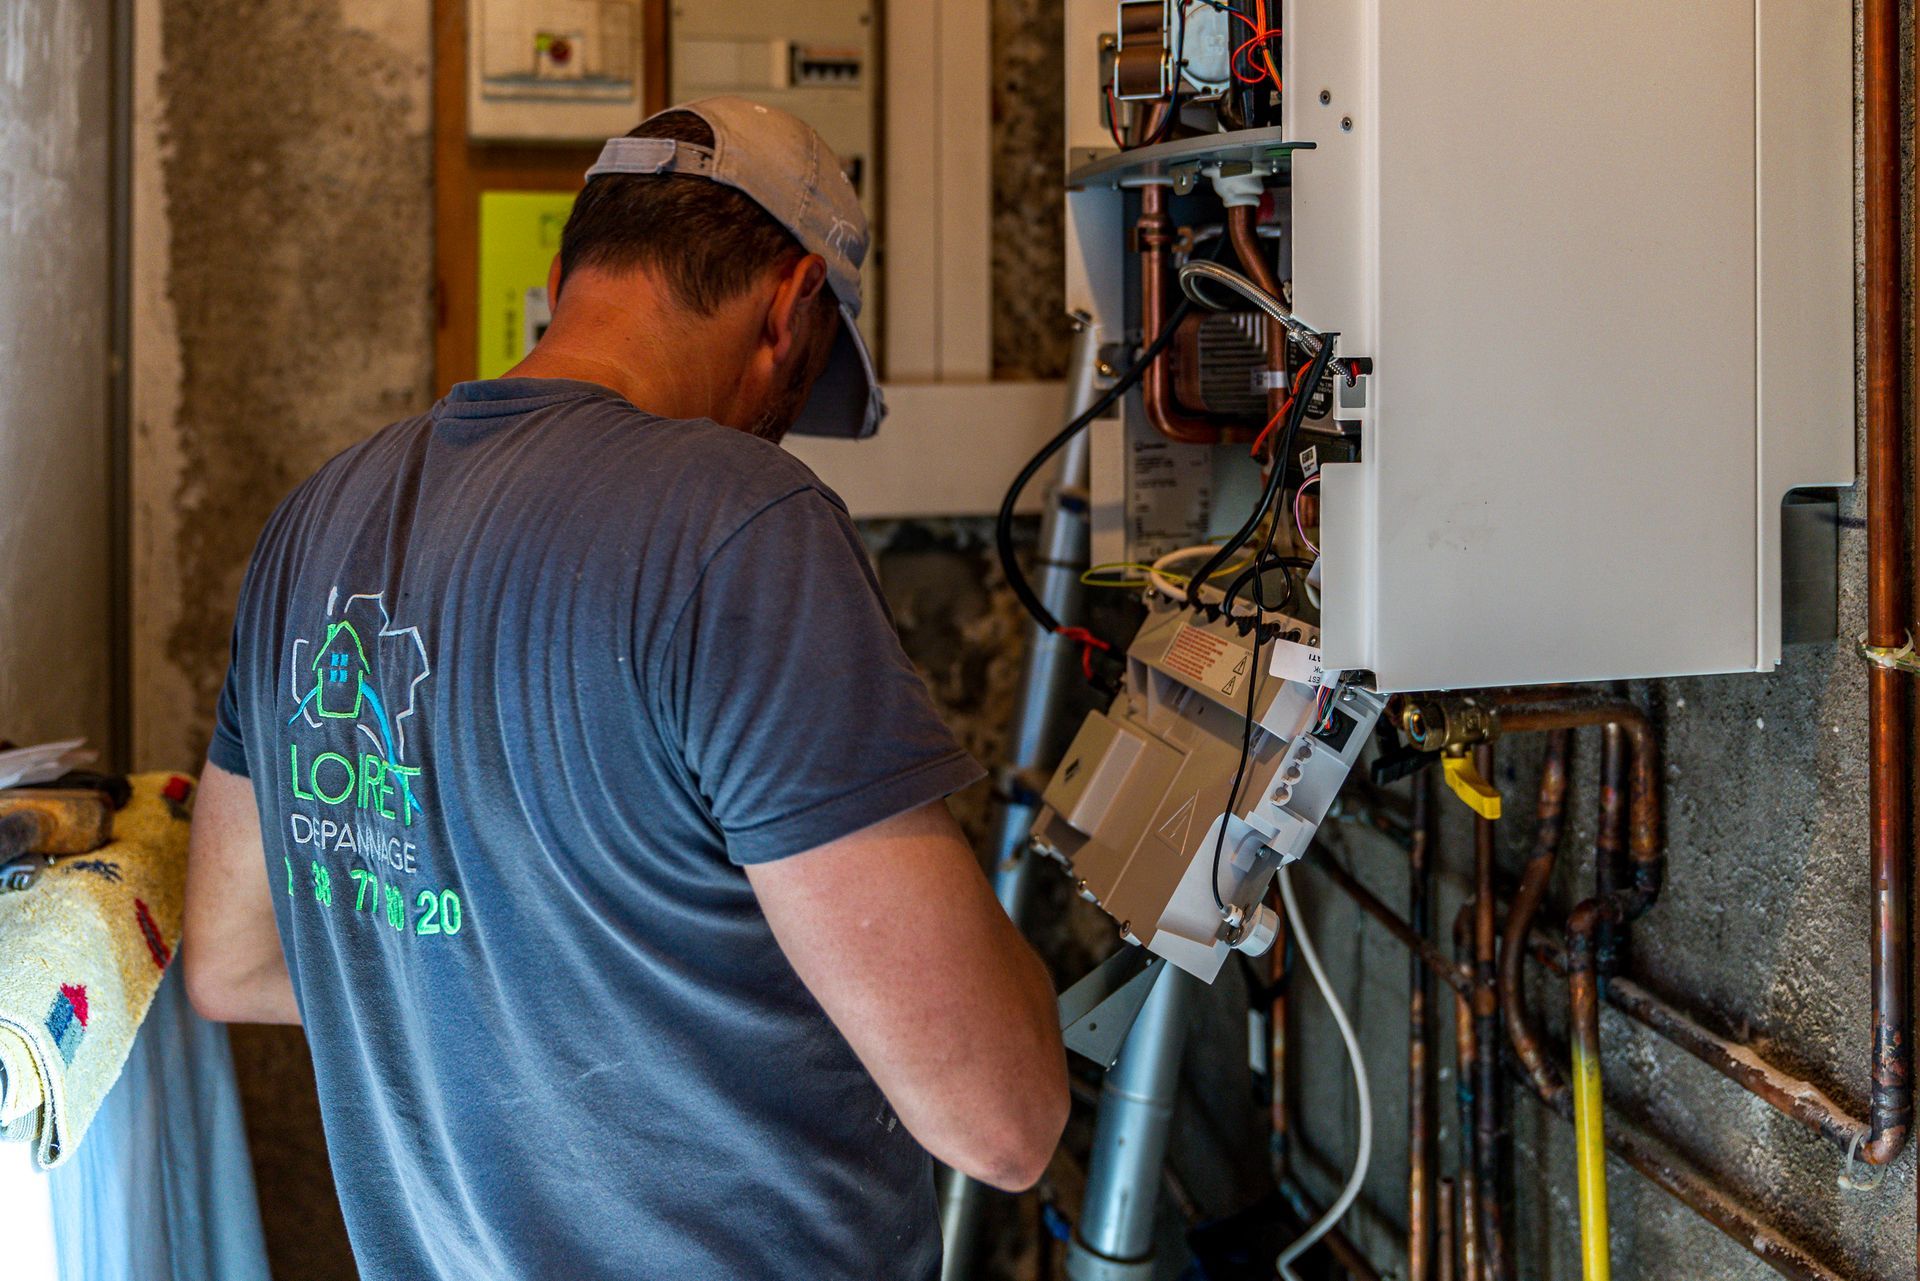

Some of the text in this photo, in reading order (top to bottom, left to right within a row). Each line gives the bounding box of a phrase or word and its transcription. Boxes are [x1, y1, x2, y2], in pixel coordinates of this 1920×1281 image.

[290, 742, 421, 826] LOIRET
[290, 813, 417, 874] DEPANNAGE
[350, 868, 378, 913] 77
[416, 888, 462, 935] 20
